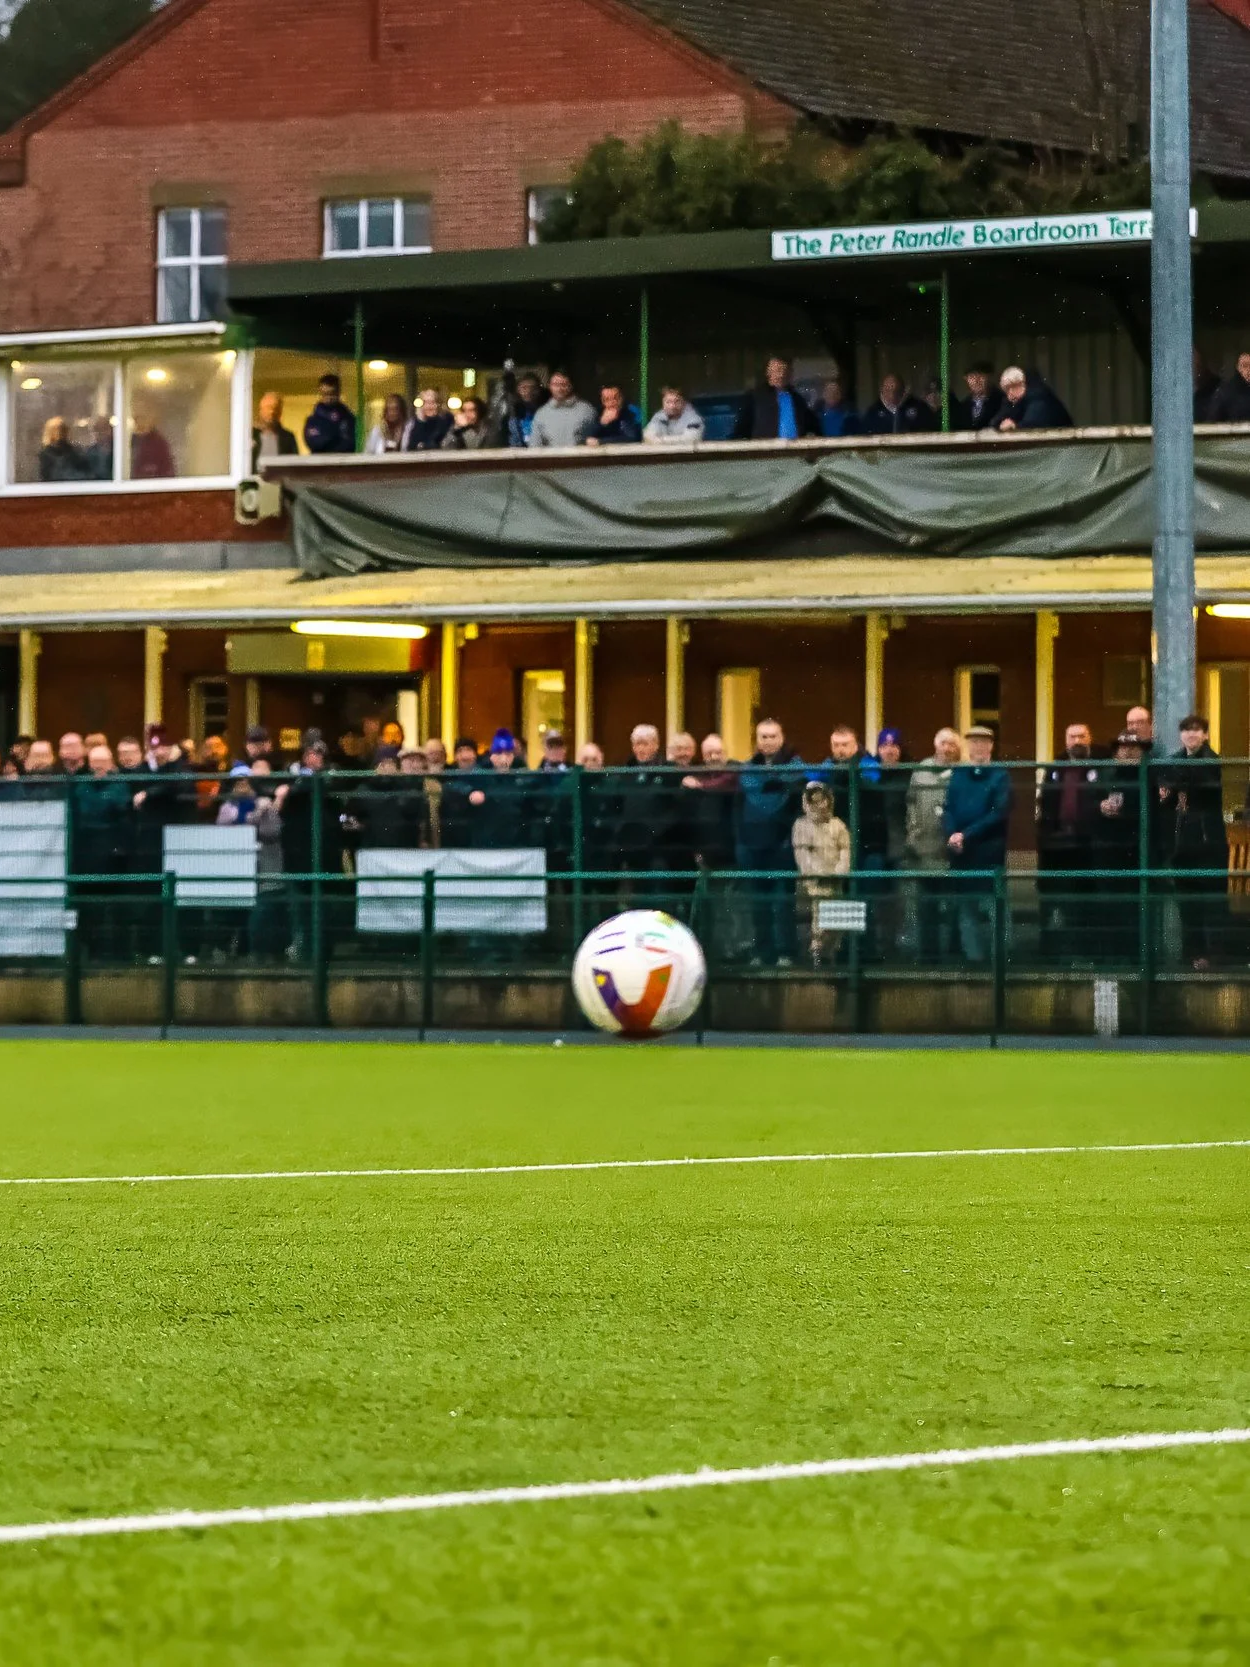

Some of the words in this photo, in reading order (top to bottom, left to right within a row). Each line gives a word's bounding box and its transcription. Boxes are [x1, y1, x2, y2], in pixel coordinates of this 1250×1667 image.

[783, 234, 822, 255] The
[829, 232, 886, 252] Peter
[893, 224, 966, 249] Randle
[973, 221, 1098, 245] Boardroom
[1106, 215, 1152, 236] Terr
